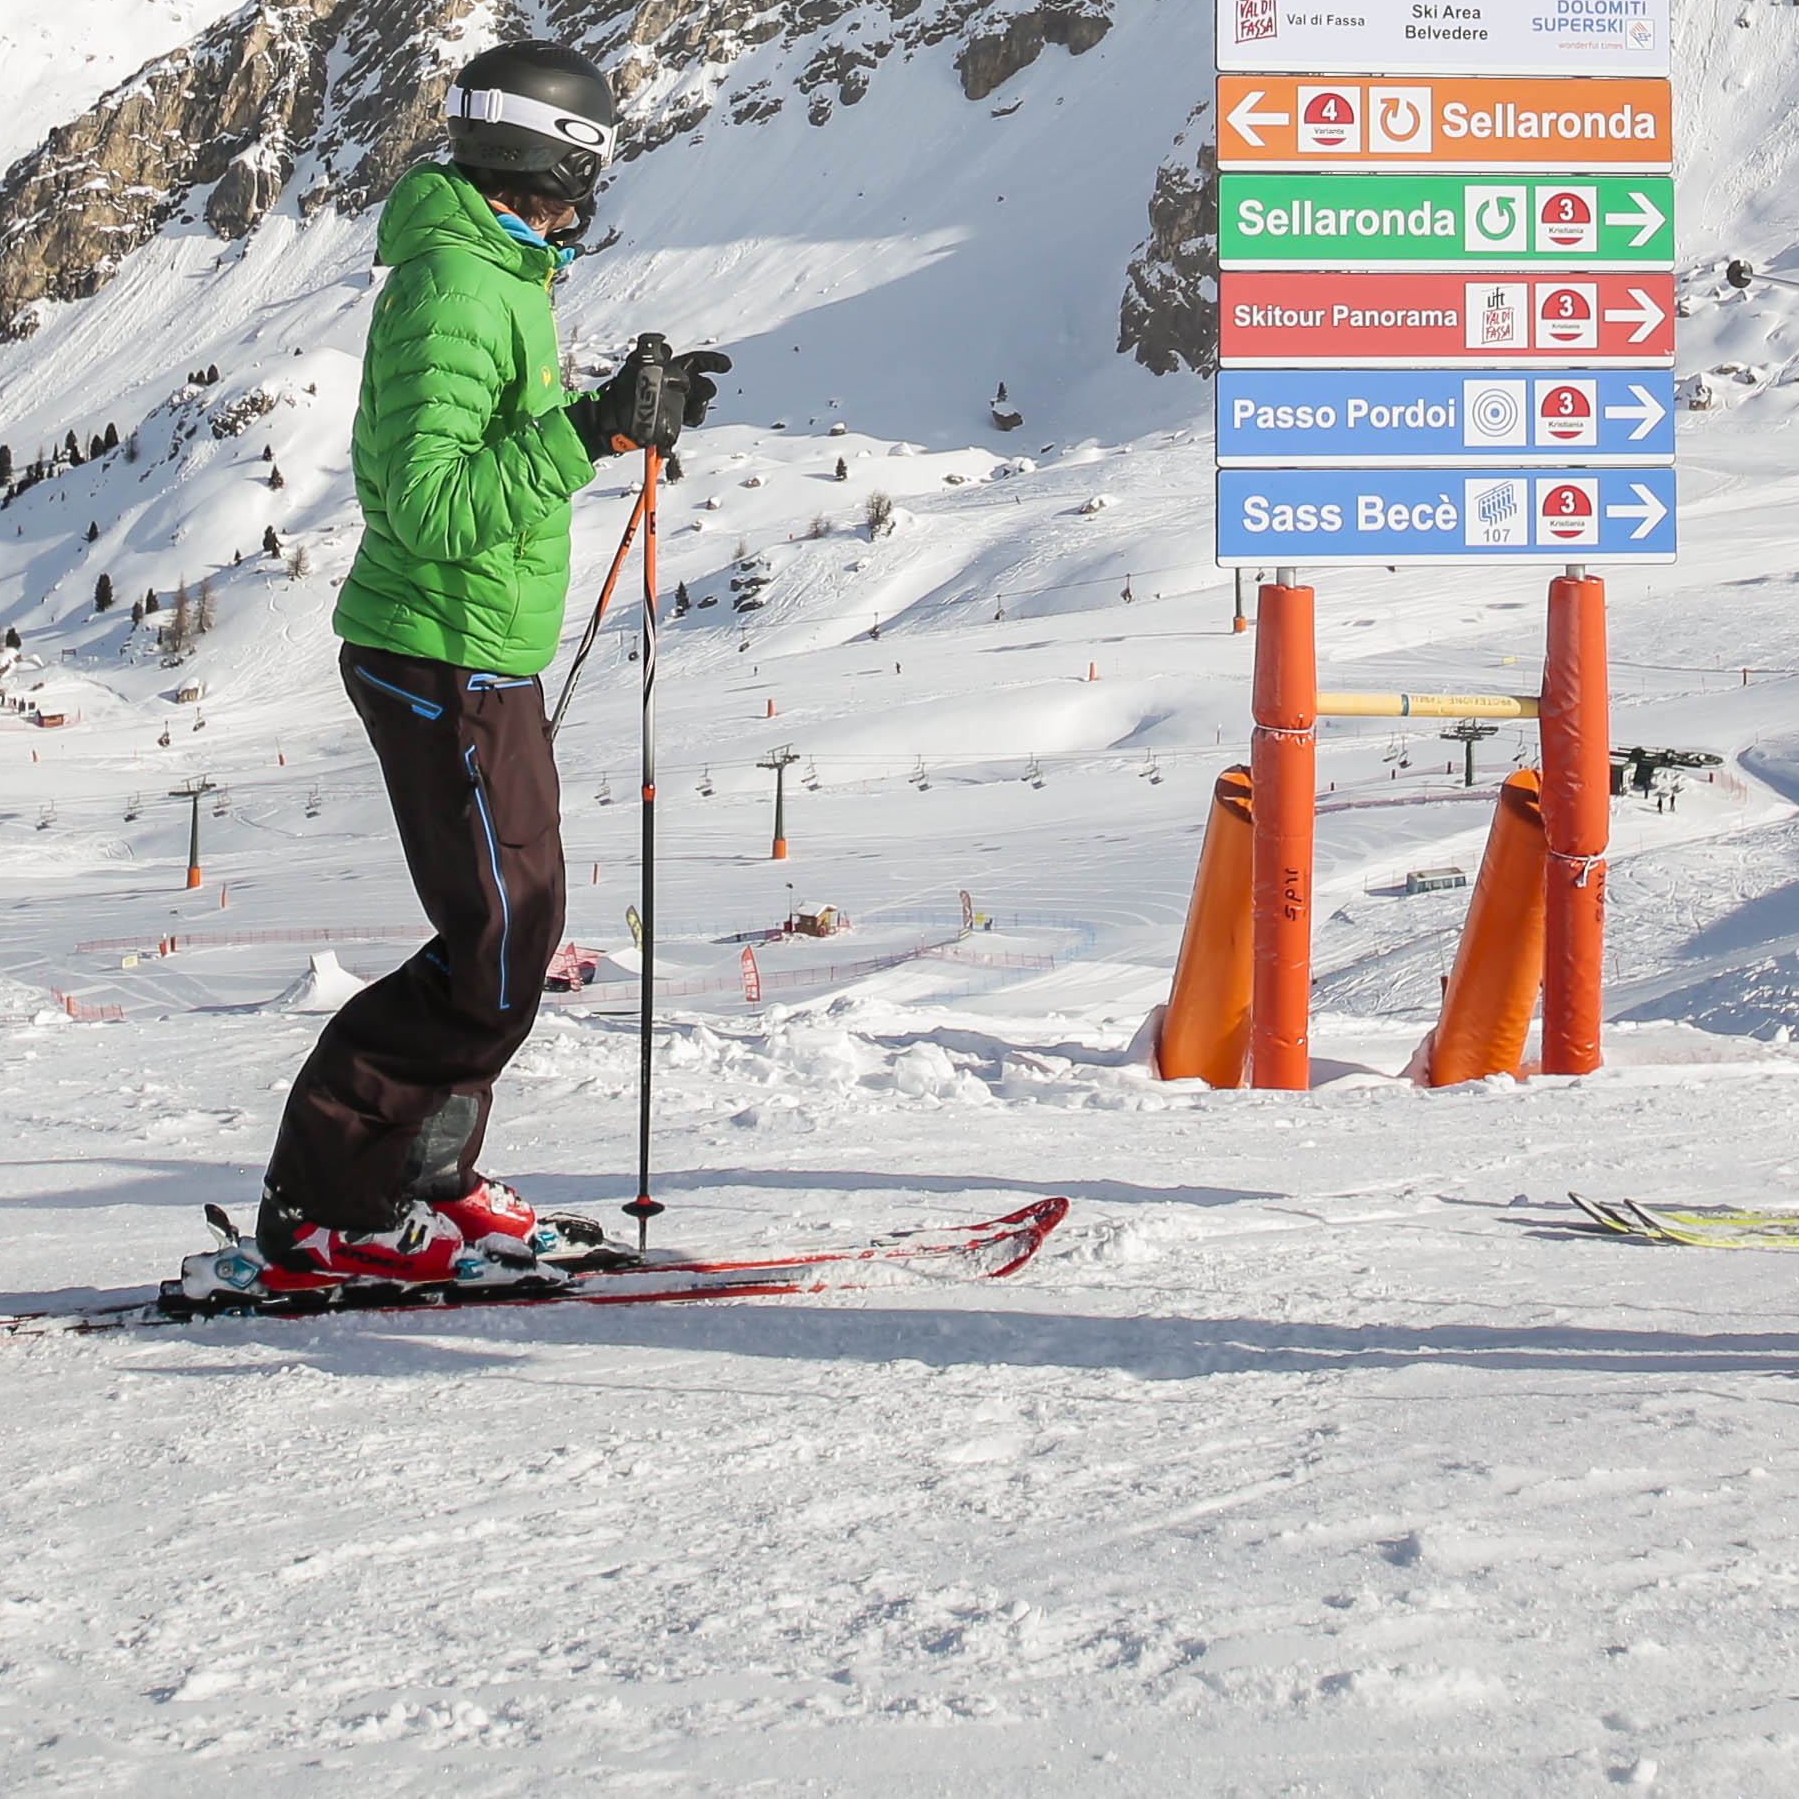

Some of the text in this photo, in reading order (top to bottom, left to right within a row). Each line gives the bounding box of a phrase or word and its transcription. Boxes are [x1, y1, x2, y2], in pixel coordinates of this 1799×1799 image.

[1240, 0, 1258, 19] VAL
[1411, 3, 1481, 19] Ski Area
[1557, 0, 1646, 15] DOLOMITI
[1240, 17, 1274, 38] FASSA
[1286, 13, 1366, 27] Val di Fassa
[1532, 17, 1623, 33] SUPERSKI
[1405, 24, 1488, 40] Belvedere
[1321, 98, 1338, 121] 4
[1441, 102, 1656, 139] Sellaronda
[1237, 199, 1456, 237] Sellaronda
[1559, 198, 1574, 221] 3
[1233, 305, 1458, 328] Skitour Panorama
[1559, 294, 1574, 317] 3
[1232, 398, 1456, 430] Passo Pordoi
[1559, 391, 1574, 415] 3
[1242, 494, 1458, 533] Sass Becè
[1560, 490, 1576, 514] 3
[1483, 529, 1511, 543] 107
